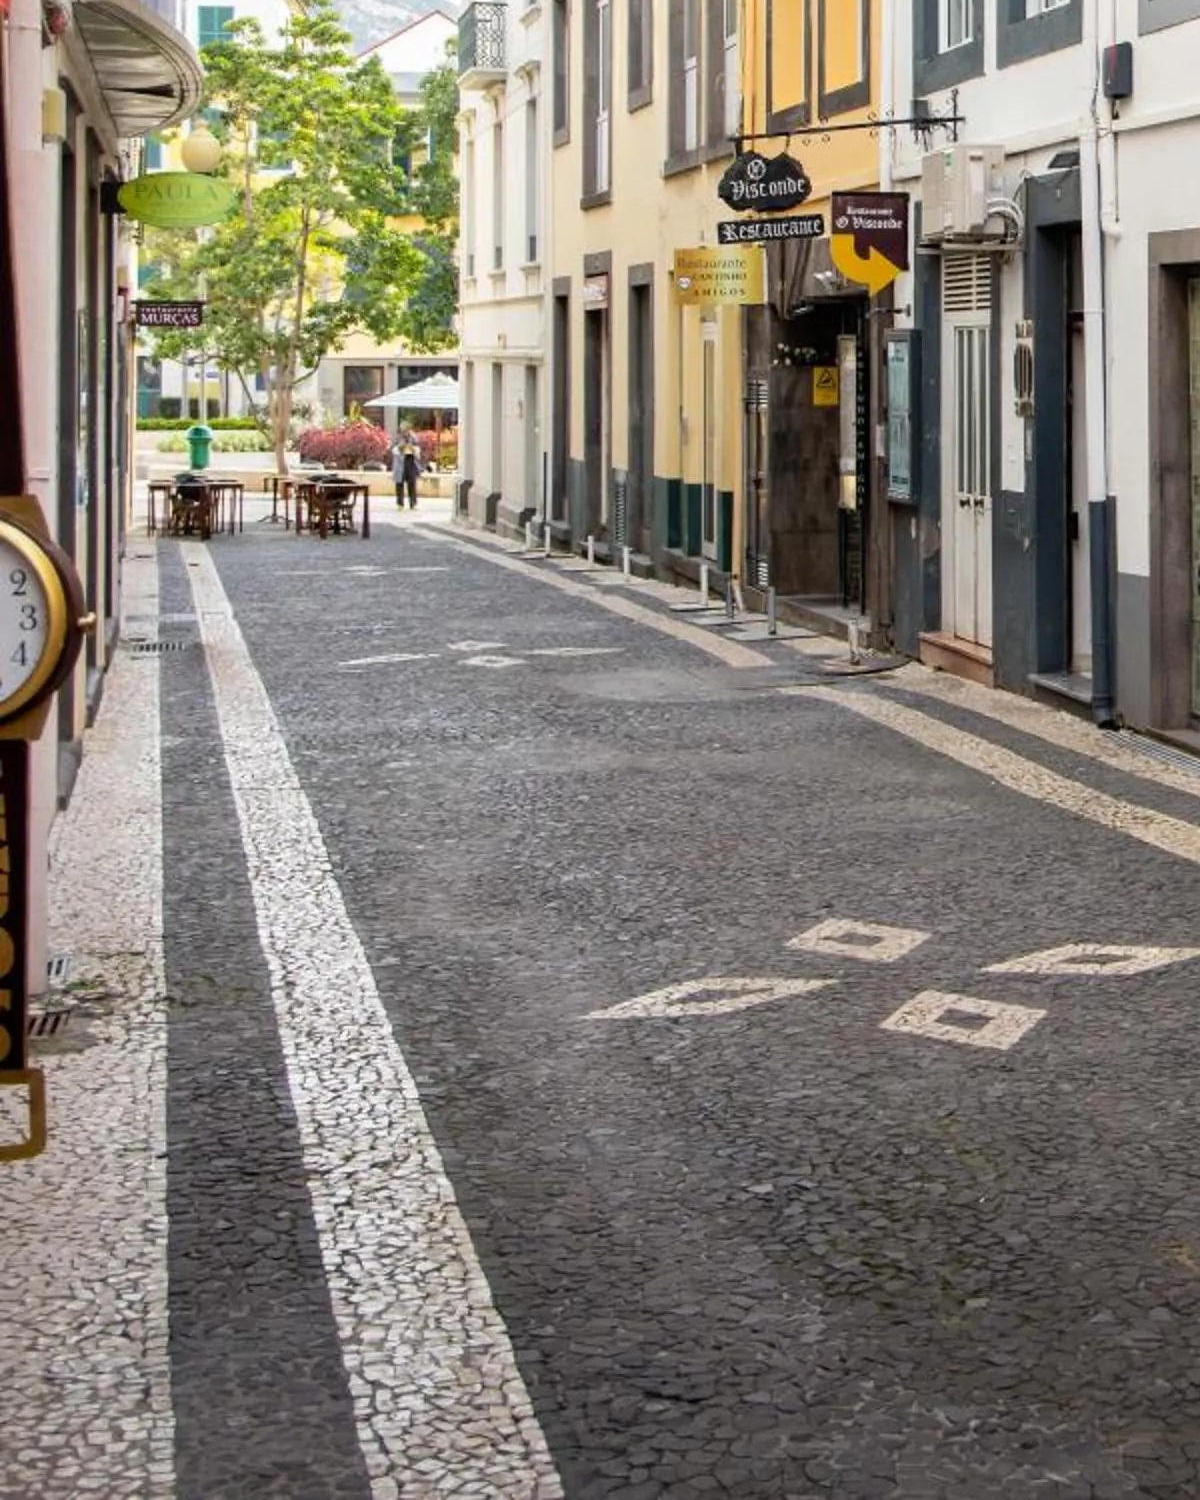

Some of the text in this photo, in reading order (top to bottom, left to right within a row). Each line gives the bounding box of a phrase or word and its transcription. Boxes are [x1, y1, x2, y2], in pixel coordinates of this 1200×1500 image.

[722, 218, 822, 241] Restaurante
[10, 568, 28, 597] 2
[19, 604, 38, 632] 3
[10, 640, 27, 667] 4
